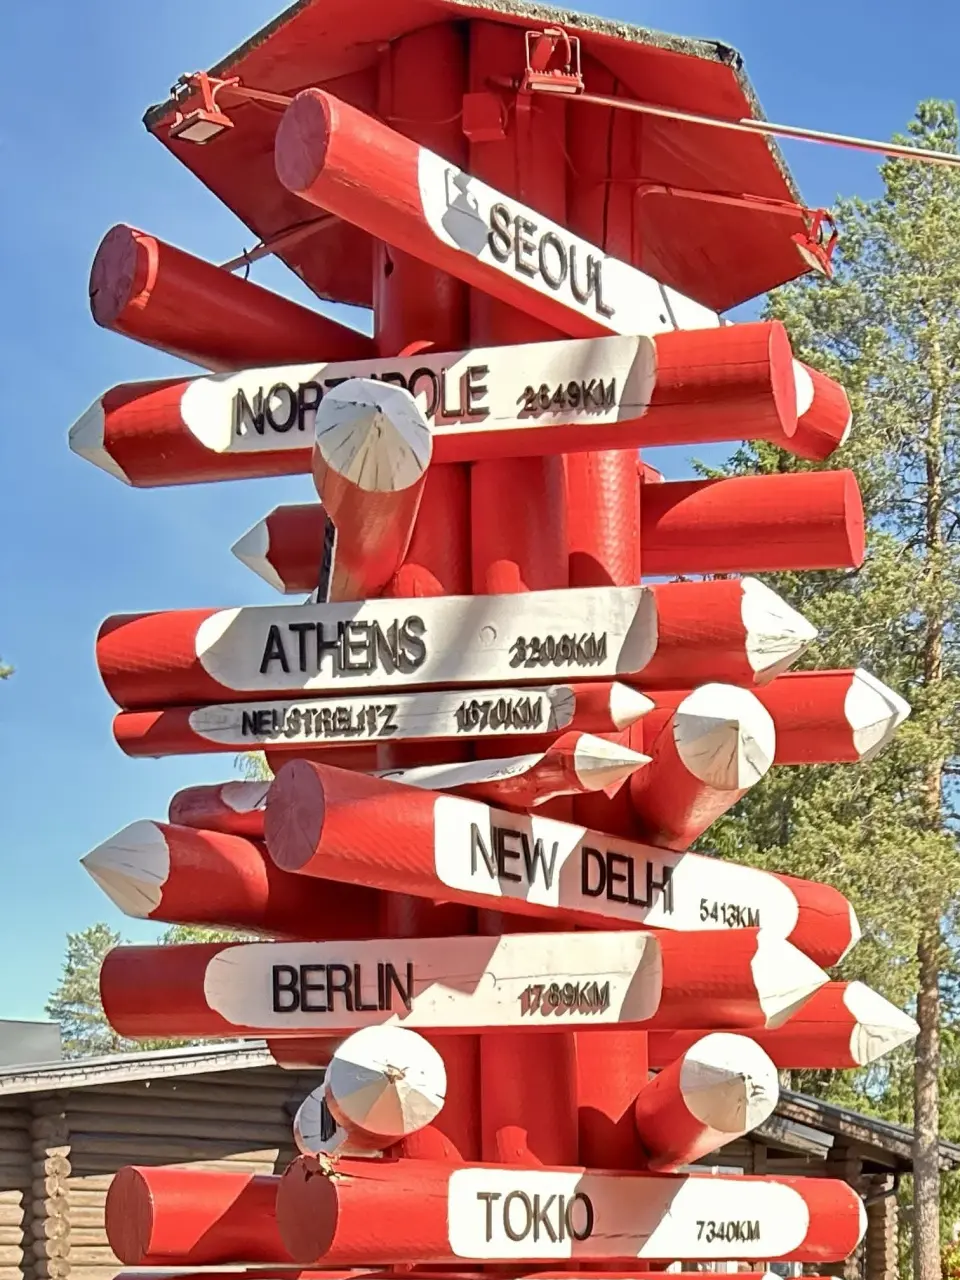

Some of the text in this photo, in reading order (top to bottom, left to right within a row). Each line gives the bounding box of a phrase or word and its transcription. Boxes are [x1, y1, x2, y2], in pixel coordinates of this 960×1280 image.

[488, 202, 615, 319] SEOUL
[518, 377, 616, 412] 2649KM
[259, 615, 427, 673] ATHENS
[242, 704, 399, 736] NEUSTRELITZ
[471, 823, 760, 928] NEW DELHI 5413KM
[272, 962, 610, 1013] BERLIN 1789KM
[476, 1190, 760, 1243] TOKIO 7340KM
